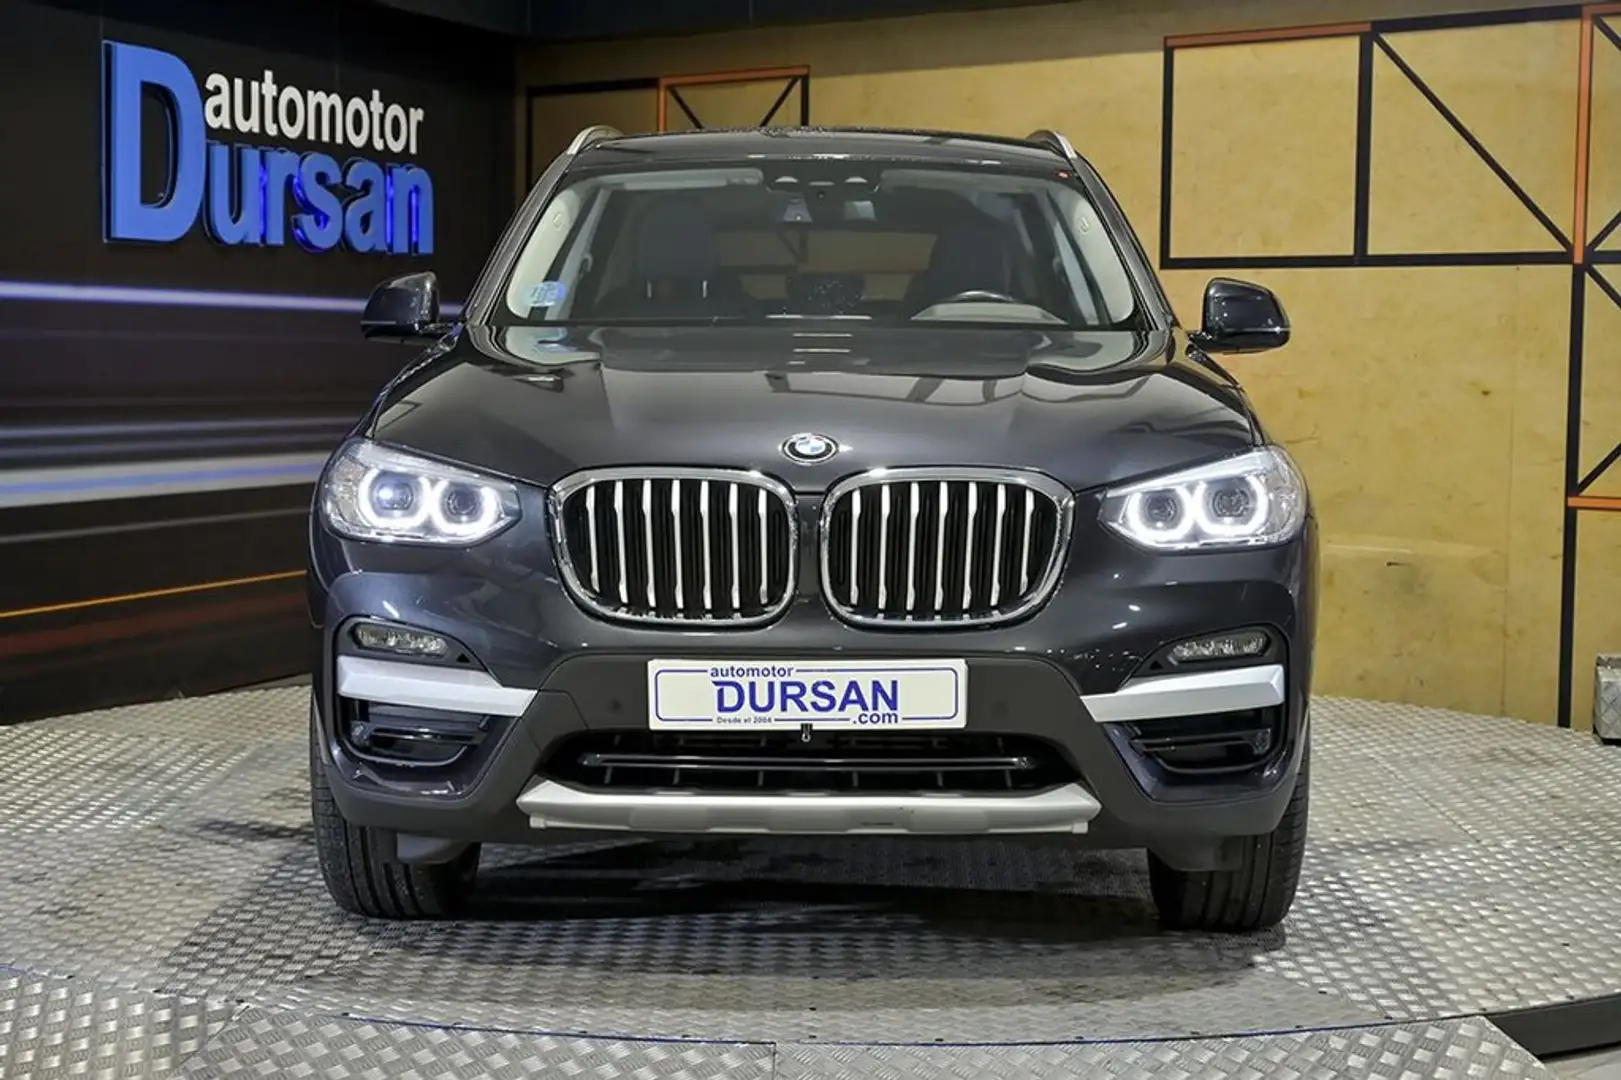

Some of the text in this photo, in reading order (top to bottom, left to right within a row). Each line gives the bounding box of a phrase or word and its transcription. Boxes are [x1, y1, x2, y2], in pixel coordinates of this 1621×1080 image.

[204, 69, 425, 155] automotor
[101, 39, 434, 256] Dursan
[710, 665, 794, 678] automotor
[711, 679, 898, 713] DURSAN
[852, 712, 899, 725] .com
